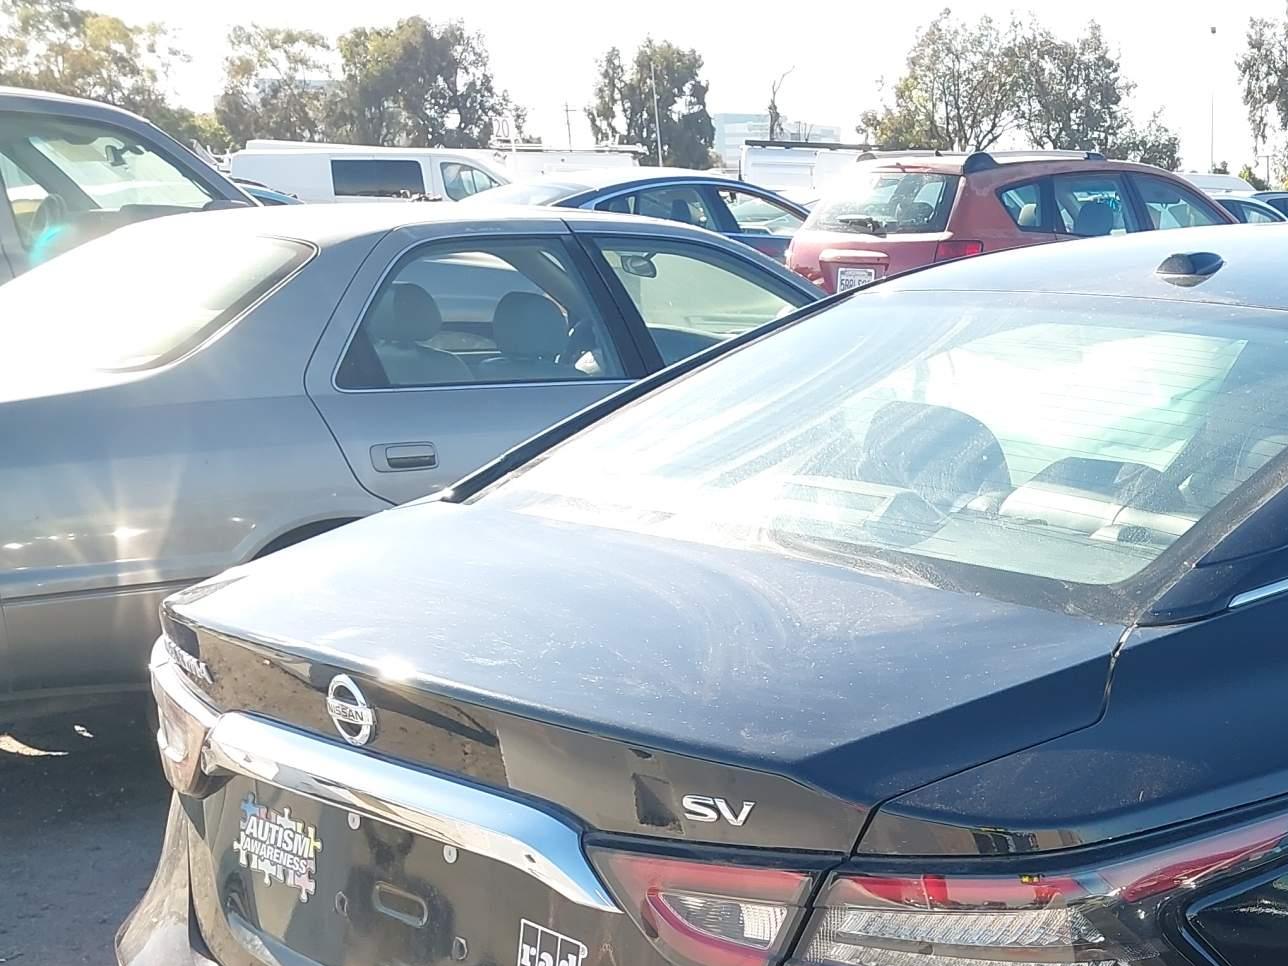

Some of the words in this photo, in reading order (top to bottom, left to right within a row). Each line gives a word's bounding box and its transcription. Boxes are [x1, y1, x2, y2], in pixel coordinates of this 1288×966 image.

[329, 702, 364, 721] NISSAN
[682, 794, 756, 826] SV
[245, 815, 315, 859] AUTISM
[242, 837, 308, 875] AWARENESS
